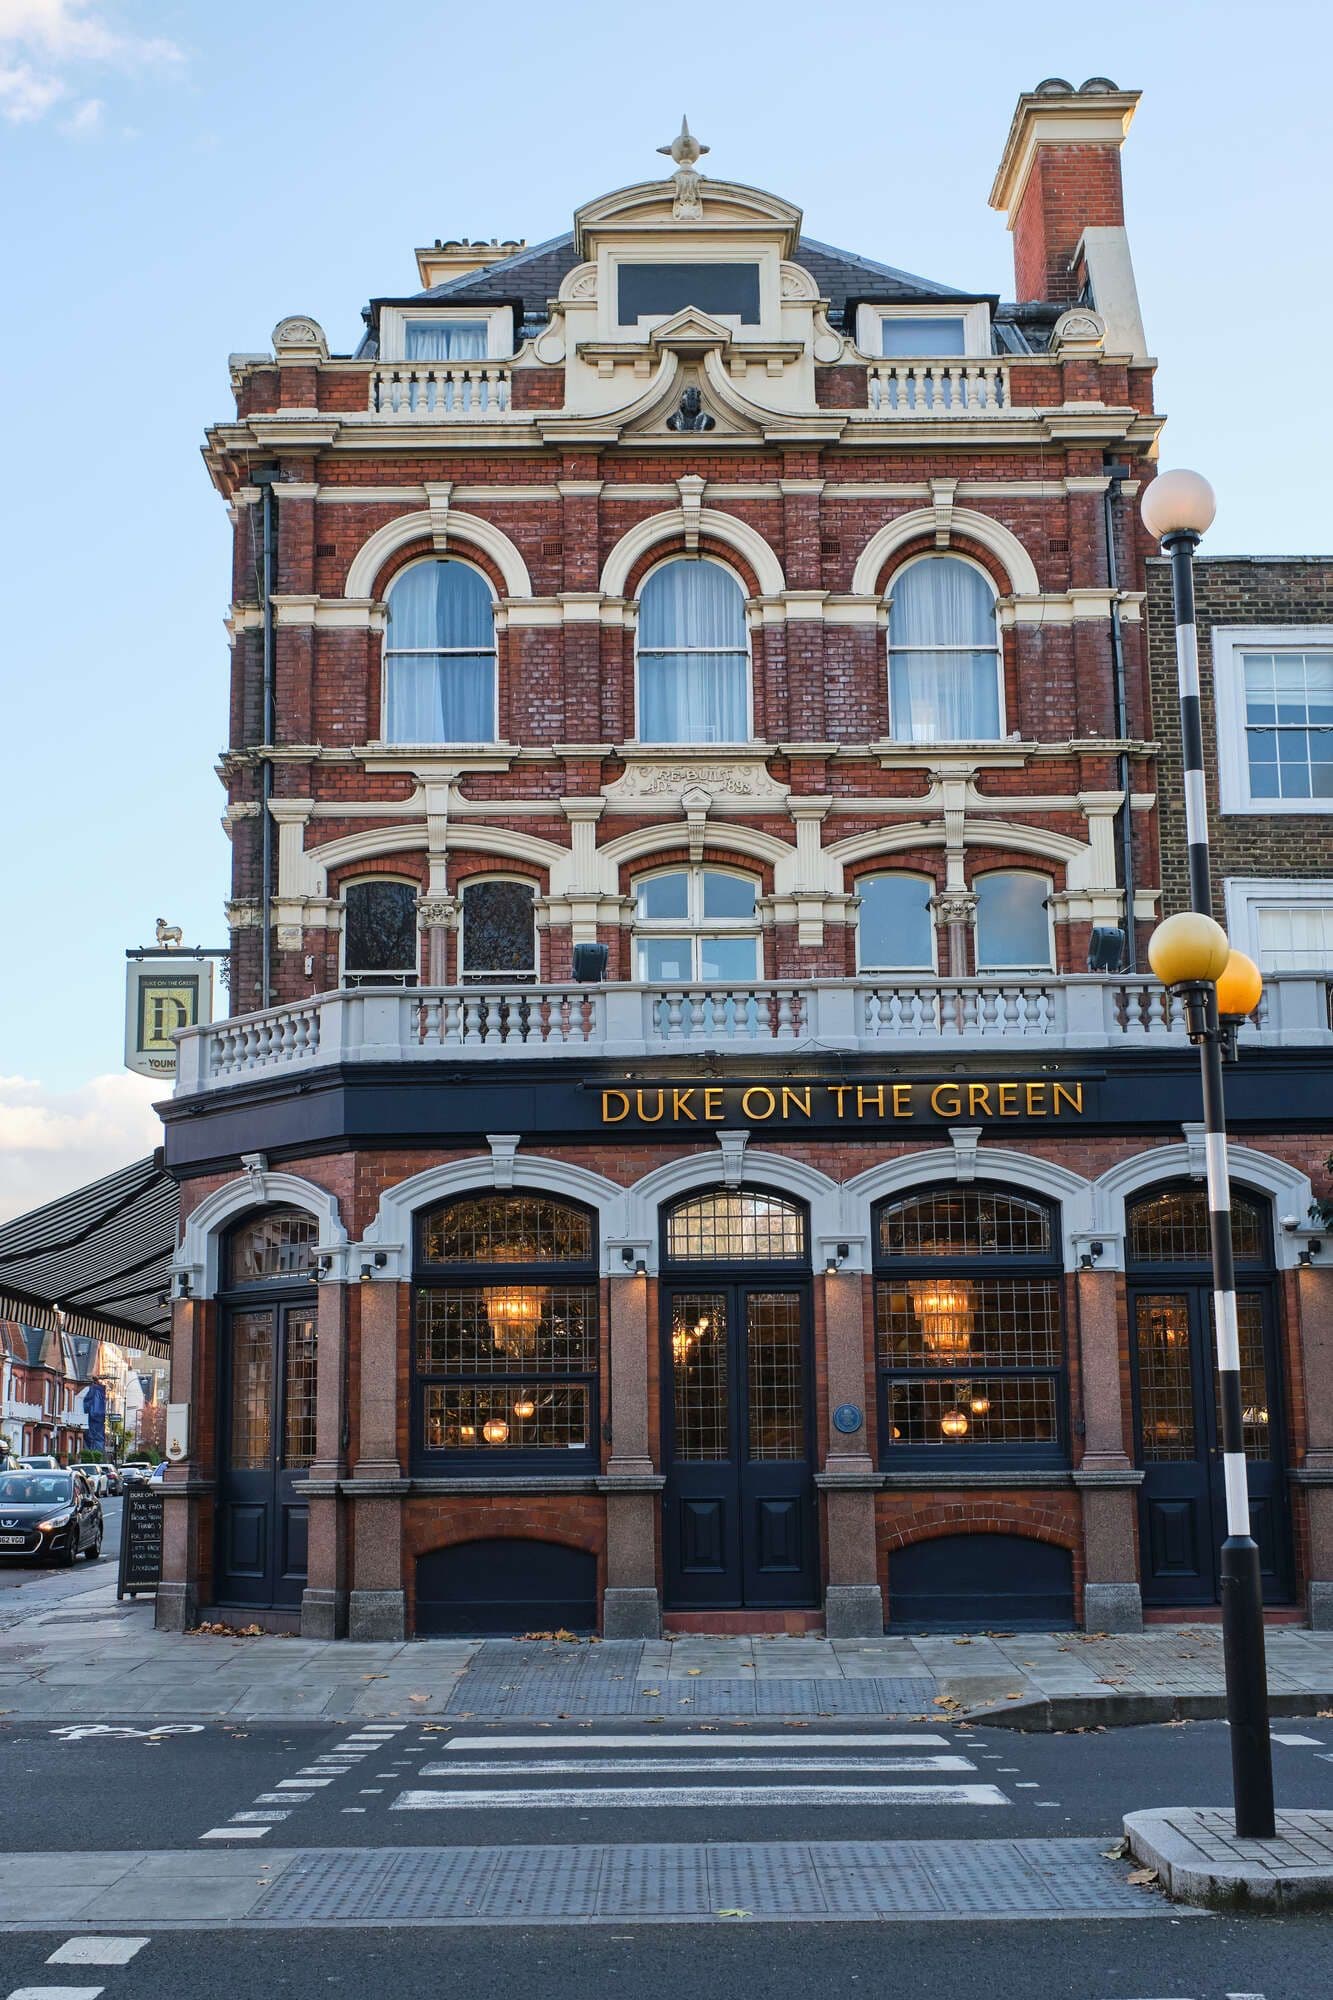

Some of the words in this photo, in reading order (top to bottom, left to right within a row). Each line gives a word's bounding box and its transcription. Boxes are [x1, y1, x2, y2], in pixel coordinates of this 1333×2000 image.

[602, 1088, 725, 1122] DUKE
[742, 1086, 811, 1120] ON
[828, 1085, 914, 1118] THE
[930, 1083, 1083, 1117] GREEN
